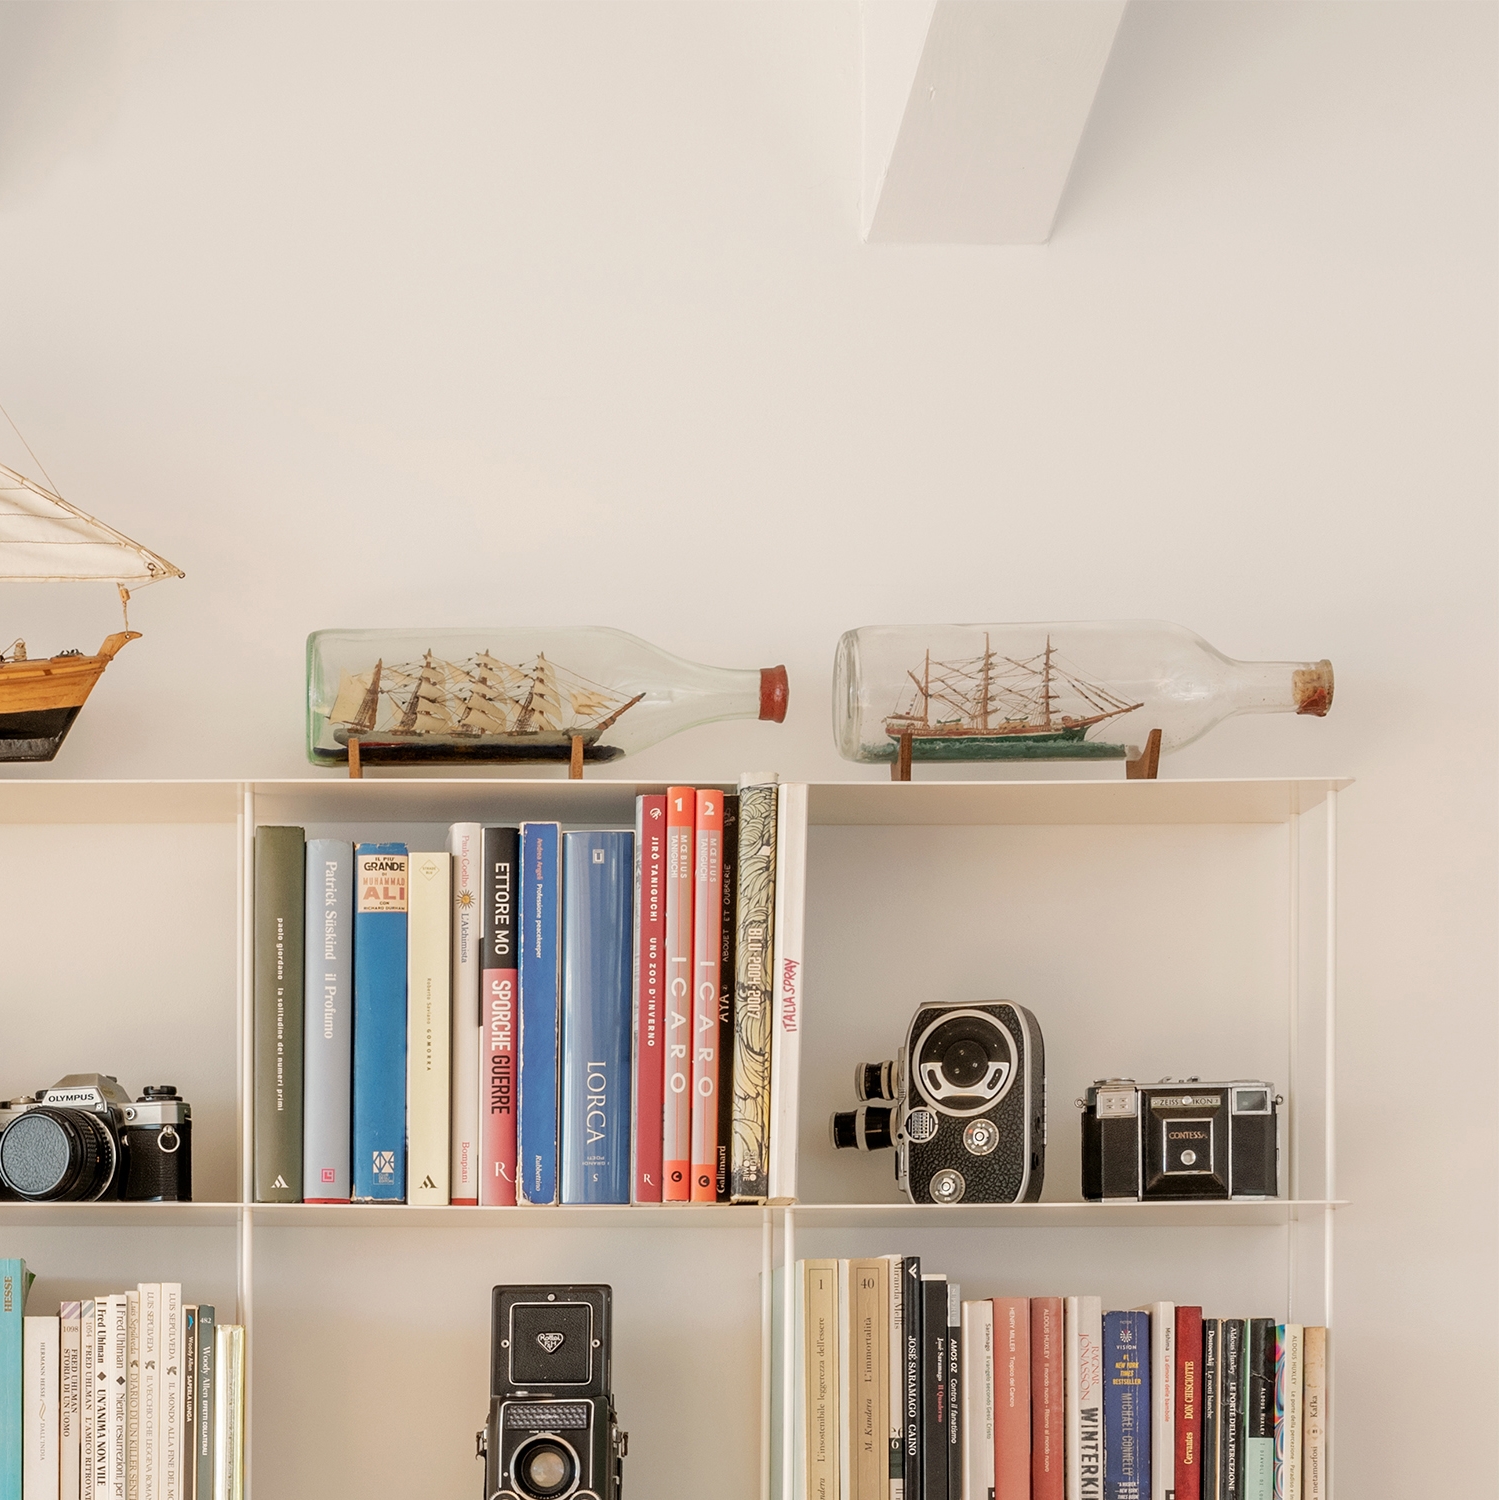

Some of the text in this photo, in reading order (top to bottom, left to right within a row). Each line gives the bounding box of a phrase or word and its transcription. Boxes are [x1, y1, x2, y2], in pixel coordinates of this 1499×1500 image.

[363, 862, 405, 871] GRANDE
[700, 838, 708, 882] TANIGUCHI
[363, 877, 405, 885] MUHAMMAD
[363, 886, 405, 900] ALI
[495, 862, 510, 955] ETTORE MO
[276, 917, 284, 941] paolo
[275, 942, 285, 980] giordano
[324, 861, 338, 1039] Patrick Süskind il Profumo
[277, 998, 285, 1040] solitudine
[698, 961, 715, 1097] ICARO
[277, 1041, 285, 1055] dei
[491, 980, 512, 1114] SPORCHE GUERRE
[48, 1093, 94, 1102] OLYMPUS
[276, 1088, 284, 1111] primi
[586, 1061, 607, 1145] LORCA
[1159, 1097, 1179, 1106] ZEISS
[3, 1276, 12, 1312] HESSE
[908, 1335, 918, 1455] JOSÉ SARAMAGO CAINO
